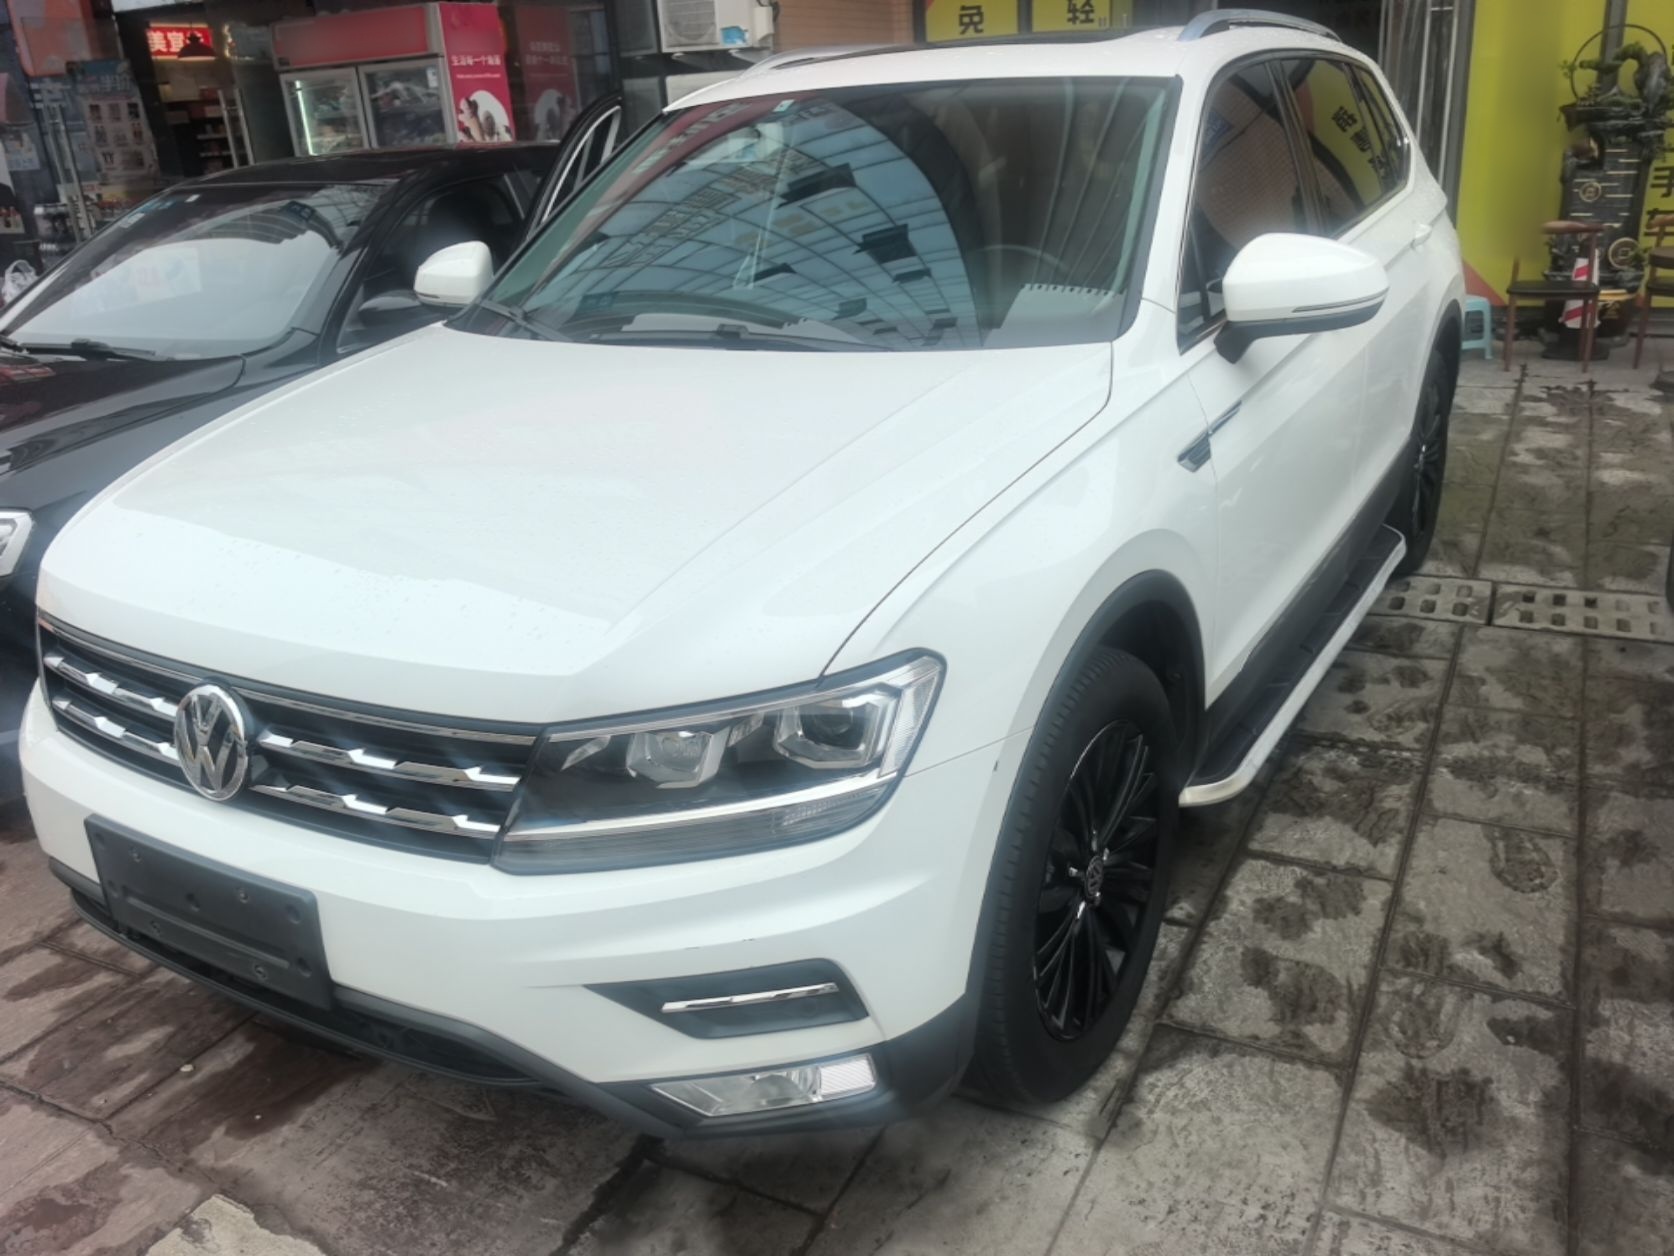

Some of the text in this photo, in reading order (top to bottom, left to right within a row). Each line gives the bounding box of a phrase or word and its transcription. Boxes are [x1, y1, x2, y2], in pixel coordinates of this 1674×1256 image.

[958, 5, 984, 35] 免
[1066, 0, 1095, 25] 轻
[147, 30, 205, 53] 美宜
